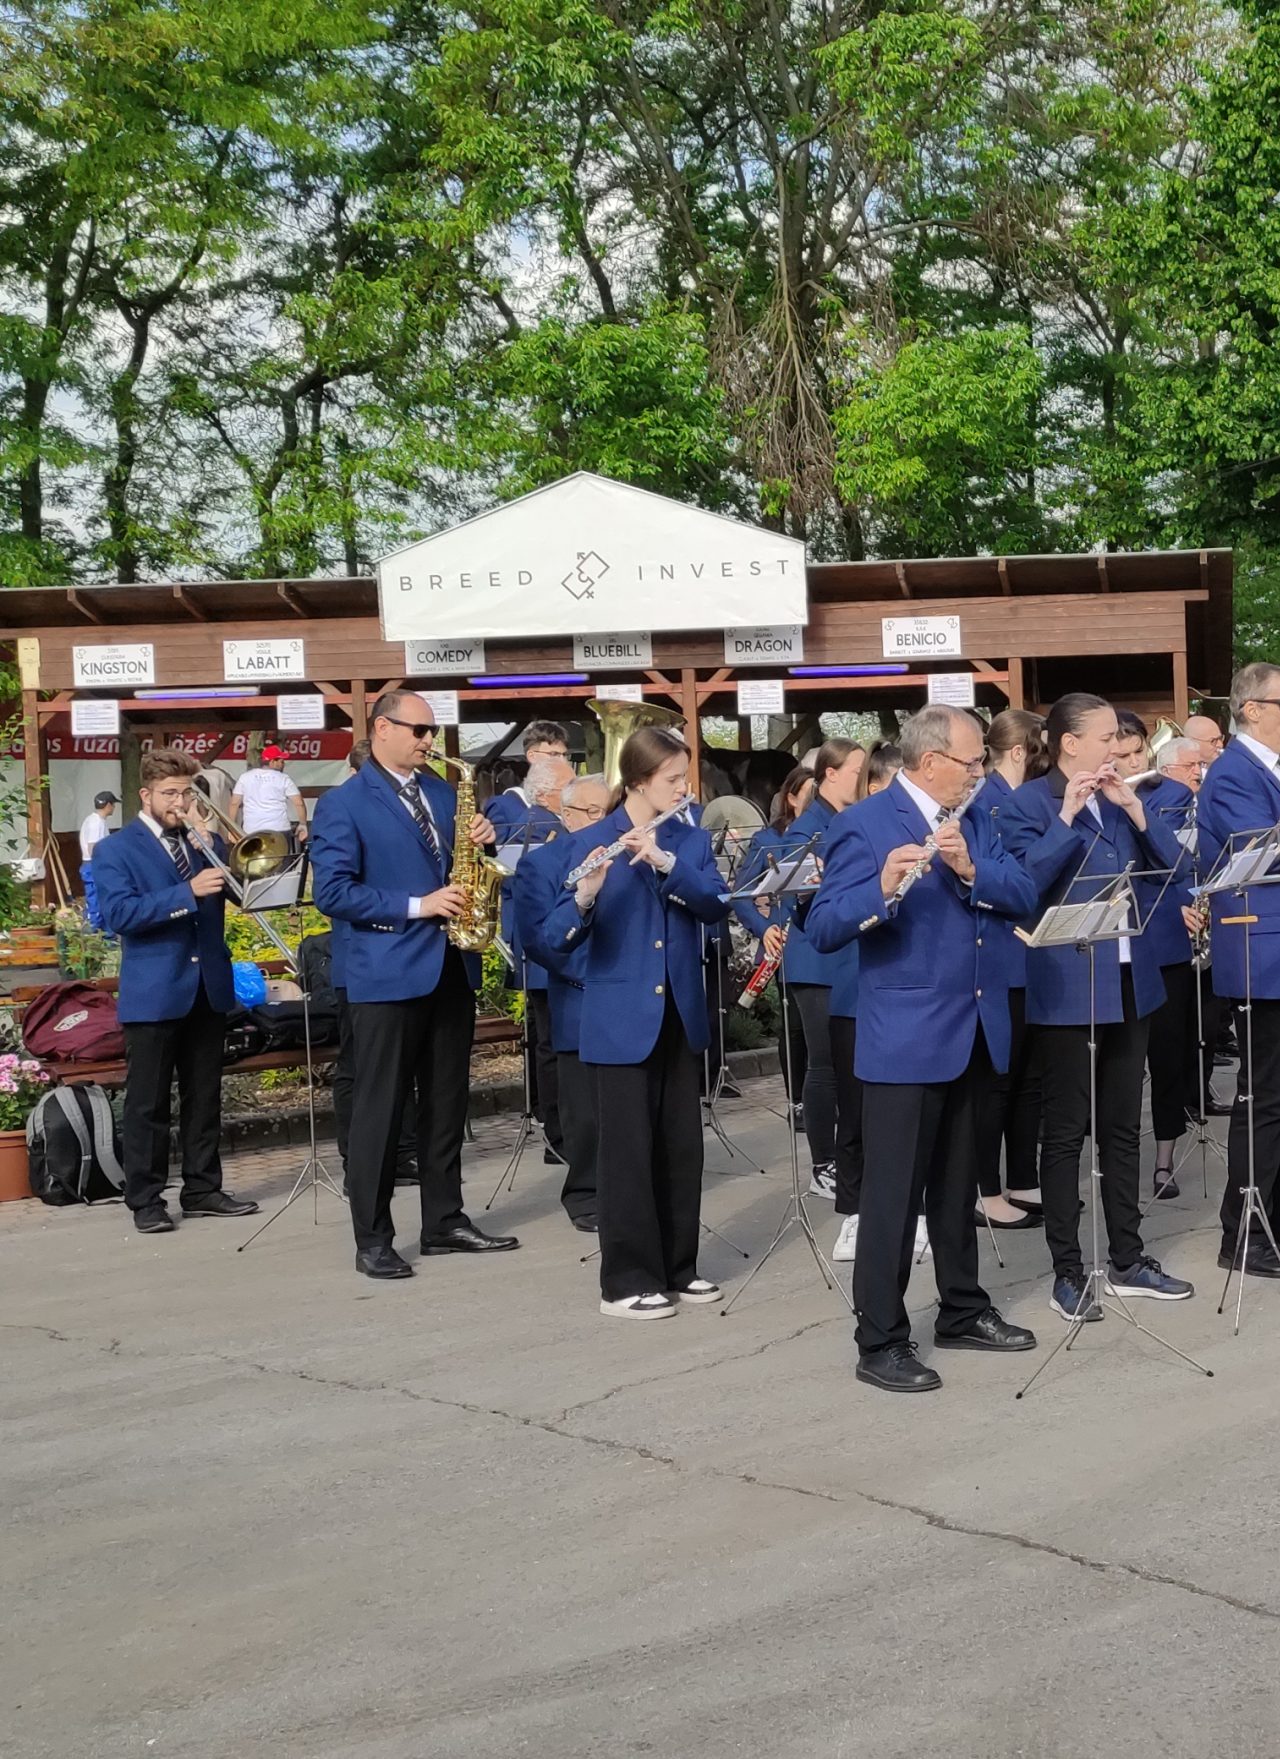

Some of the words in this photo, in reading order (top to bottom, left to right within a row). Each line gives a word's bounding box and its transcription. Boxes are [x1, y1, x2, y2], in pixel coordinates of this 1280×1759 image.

[399, 569, 533, 592] BREED
[637, 559, 789, 581] INVEST
[734, 638, 793, 653] DRAGON
[896, 632, 947, 646] BENICIO
[416, 649, 473, 663] COMEDY
[583, 643, 642, 658] BLUEBILL
[80, 660, 148, 675] KINGSTON
[236, 655, 291, 670] LABATT
